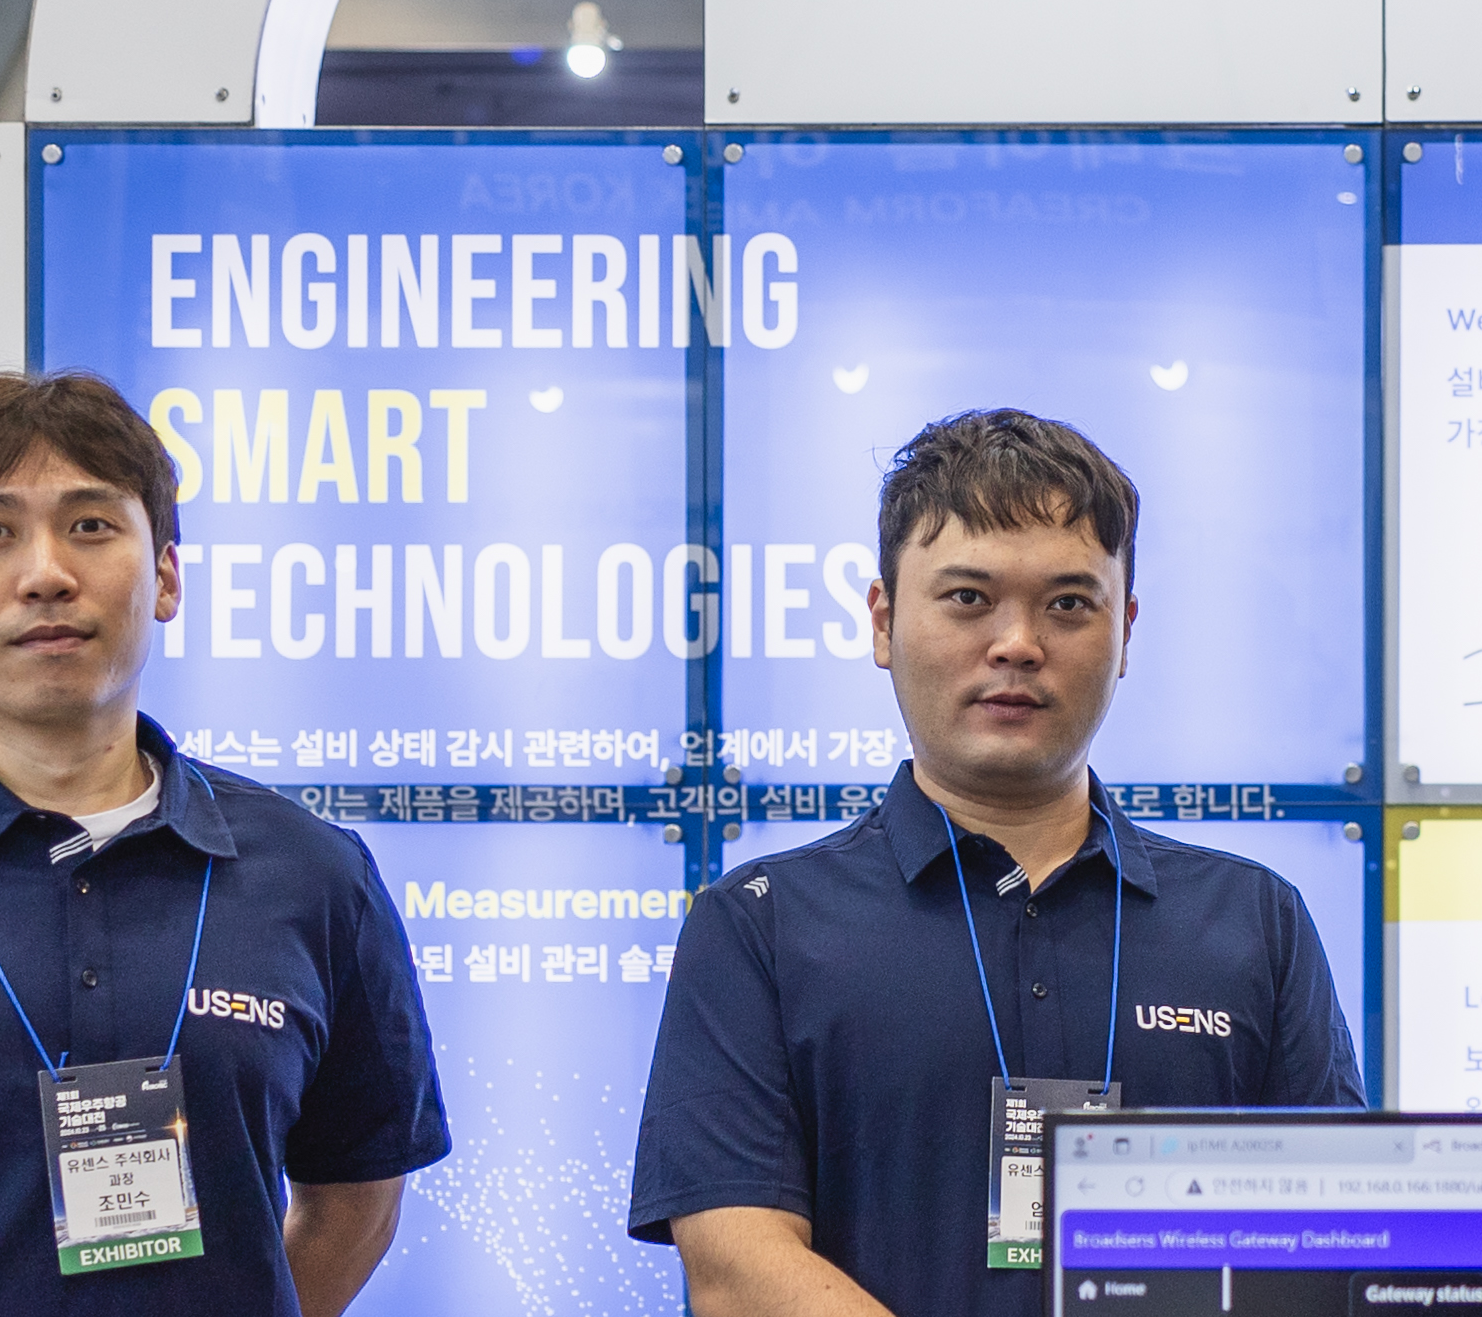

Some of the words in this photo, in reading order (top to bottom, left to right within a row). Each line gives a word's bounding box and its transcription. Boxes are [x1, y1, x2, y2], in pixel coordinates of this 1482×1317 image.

[150, 232, 800, 350] ENGINEERING
[148, 388, 486, 504] SMART
[168, 728, 283, 768] 센스는
[291, 728, 359, 768] 설비
[368, 728, 437, 768] 상태
[446, 728, 513, 768] 감시
[522, 728, 670, 771] 관련하여,
[679, 729, 817, 768] 업계에서
[828, 728, 898, 768] 가장
[301, 785, 369, 822] 있는
[378, 784, 481, 822] 제품을
[491, 784, 636, 827] 제공하며,
[647, 785, 750, 823] 고객의
[759, 784, 815, 822] 설비
[1172, 784, 1286, 822] 합니다.
[405, 881, 708, 920] Measuremen
[410, 943, 454, 983] 된
[463, 943, 531, 983] 설비
[540, 943, 608, 983] 관리
[188, 988, 285, 1029] USENS
[1134, 1003, 1232, 1038] USENS
[59, 1111, 106, 1128] 기술대전
[67, 1157, 109, 1174] 유센스
[115, 1147, 171, 1168] 주식회사
[109, 1172, 134, 1187] 과장
[98, 1190, 151, 1213] 조민수
[79, 1237, 182, 1267] EXHIBITOR
[1073, 1230, 1156, 1249] Broadsens
[1159, 1230, 1226, 1249] Wireless
[1228, 1230, 1299, 1253] Gateway
[1301, 1230, 1391, 1249] Dashboard
[1104, 1281, 1147, 1297] Home
[1365, 1284, 1435, 1307] Gateway
